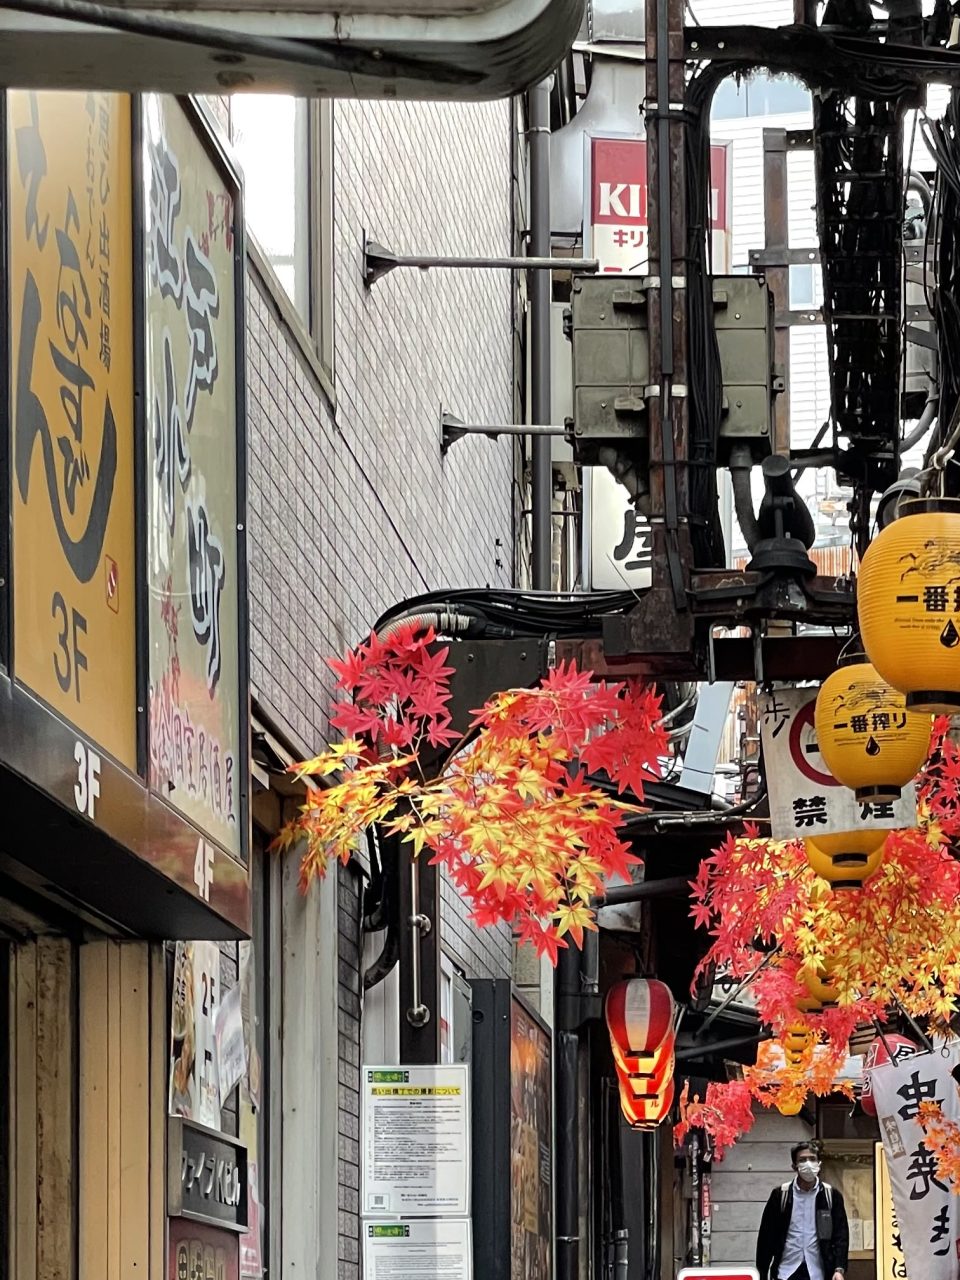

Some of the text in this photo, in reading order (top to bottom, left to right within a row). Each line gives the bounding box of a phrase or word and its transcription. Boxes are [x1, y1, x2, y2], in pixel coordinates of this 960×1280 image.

[613, 229, 645, 248] キリ
[51, 591, 88, 703] 3F
[833, 712, 907, 734] 一番搾り
[74, 741, 101, 820] 3F
[193, 836, 215, 903] 4F
